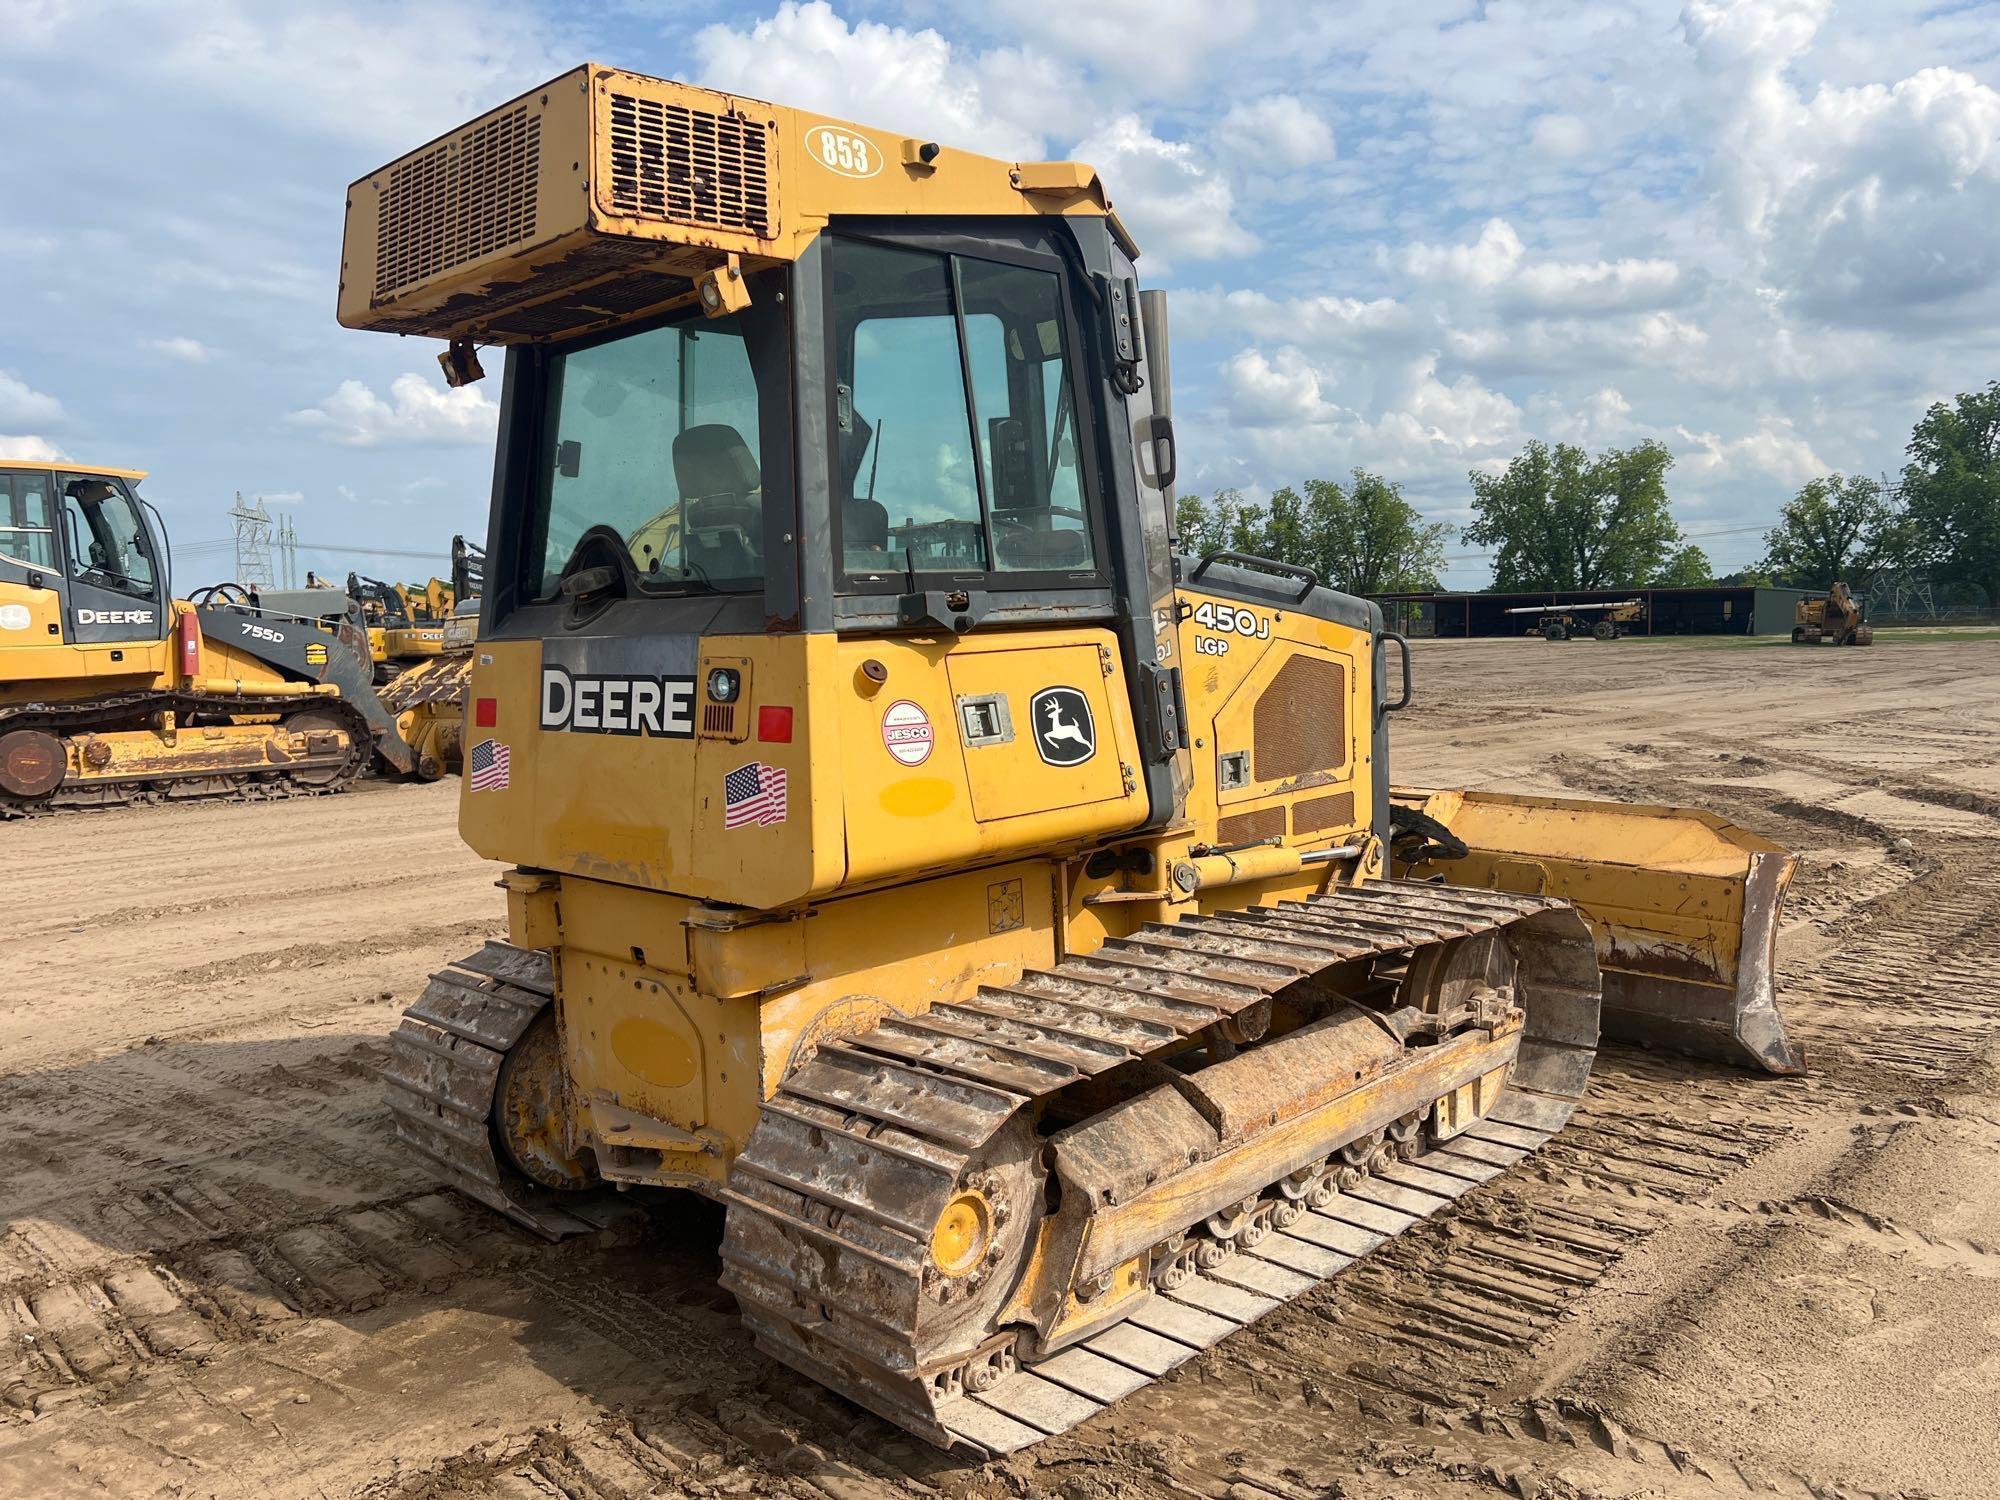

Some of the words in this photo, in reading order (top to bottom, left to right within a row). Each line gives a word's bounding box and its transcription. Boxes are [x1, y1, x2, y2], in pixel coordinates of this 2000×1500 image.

[820, 130, 868, 173] 853
[77, 609, 154, 626] DEERE
[1194, 601, 1270, 640] 450J
[240, 622, 285, 644] 755D
[421, 632, 445, 640] DEER
[1194, 634, 1229, 657] LGP
[541, 668, 695, 734] DEERE
[887, 727, 930, 741] JESCO
